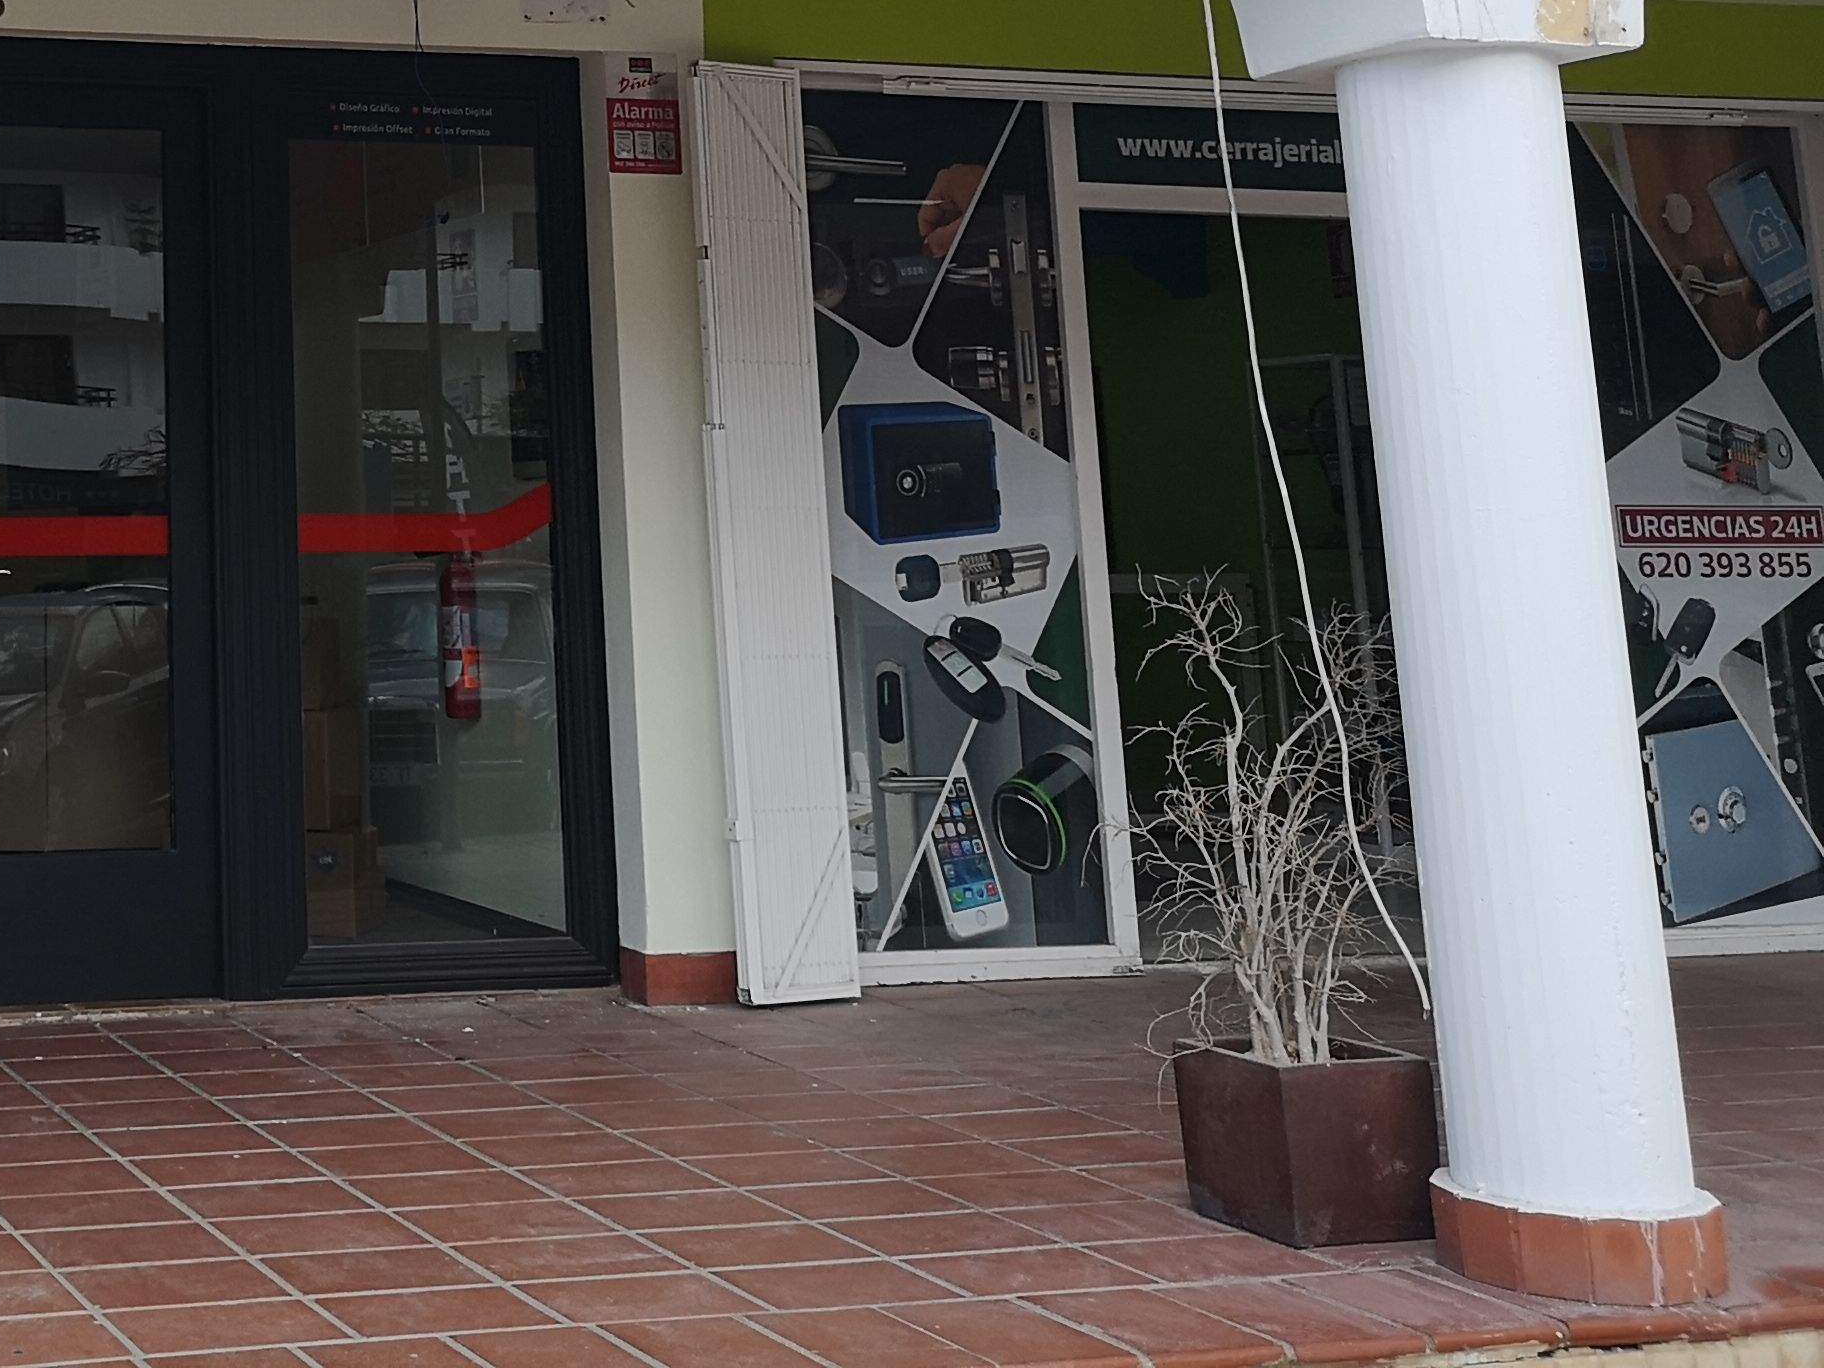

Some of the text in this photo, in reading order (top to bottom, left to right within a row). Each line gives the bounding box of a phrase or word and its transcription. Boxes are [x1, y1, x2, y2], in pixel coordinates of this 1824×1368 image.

[612, 102, 674, 120] Alarma
[1625, 515, 1819, 538] URGENCIAS 24H
[1638, 552, 1812, 578] 620 393 855
